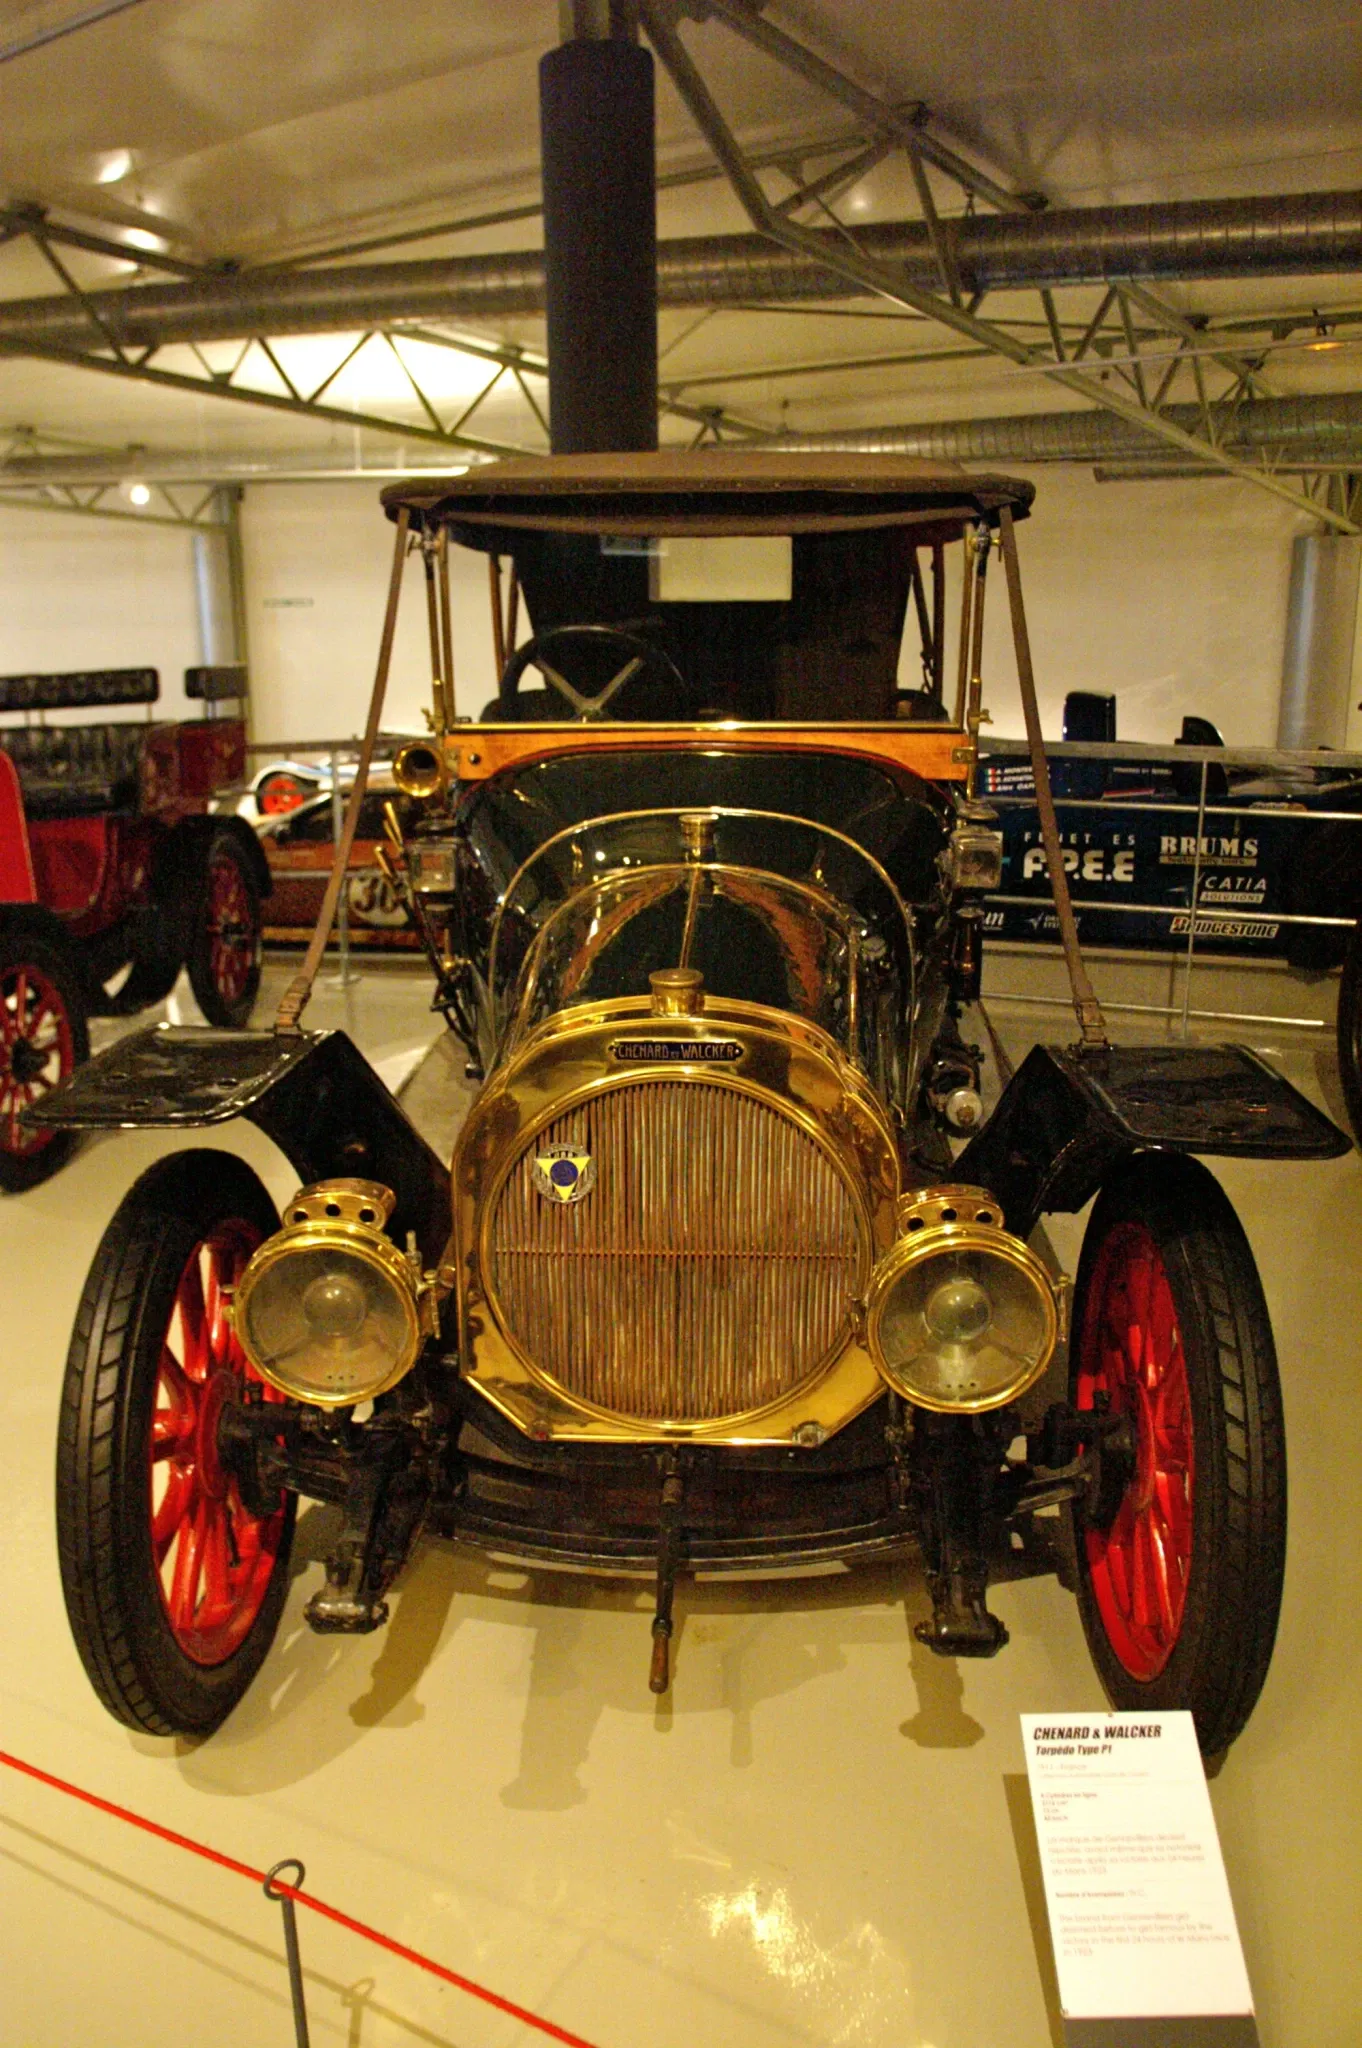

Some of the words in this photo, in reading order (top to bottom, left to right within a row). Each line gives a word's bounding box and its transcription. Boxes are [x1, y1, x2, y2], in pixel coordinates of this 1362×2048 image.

[1160, 836, 1259, 857] BRUMS
[1204, 876, 1267, 891] CATIA
[618, 1044, 669, 1059] CHENARD
[681, 1044, 733, 1059] WALCKER
[1033, 1727, 1090, 1740] CHENARD
[1092, 1728, 1101, 1739] &
[1104, 1725, 1162, 1739] WALCKER
[1077, 1744, 1100, 1756] Type
